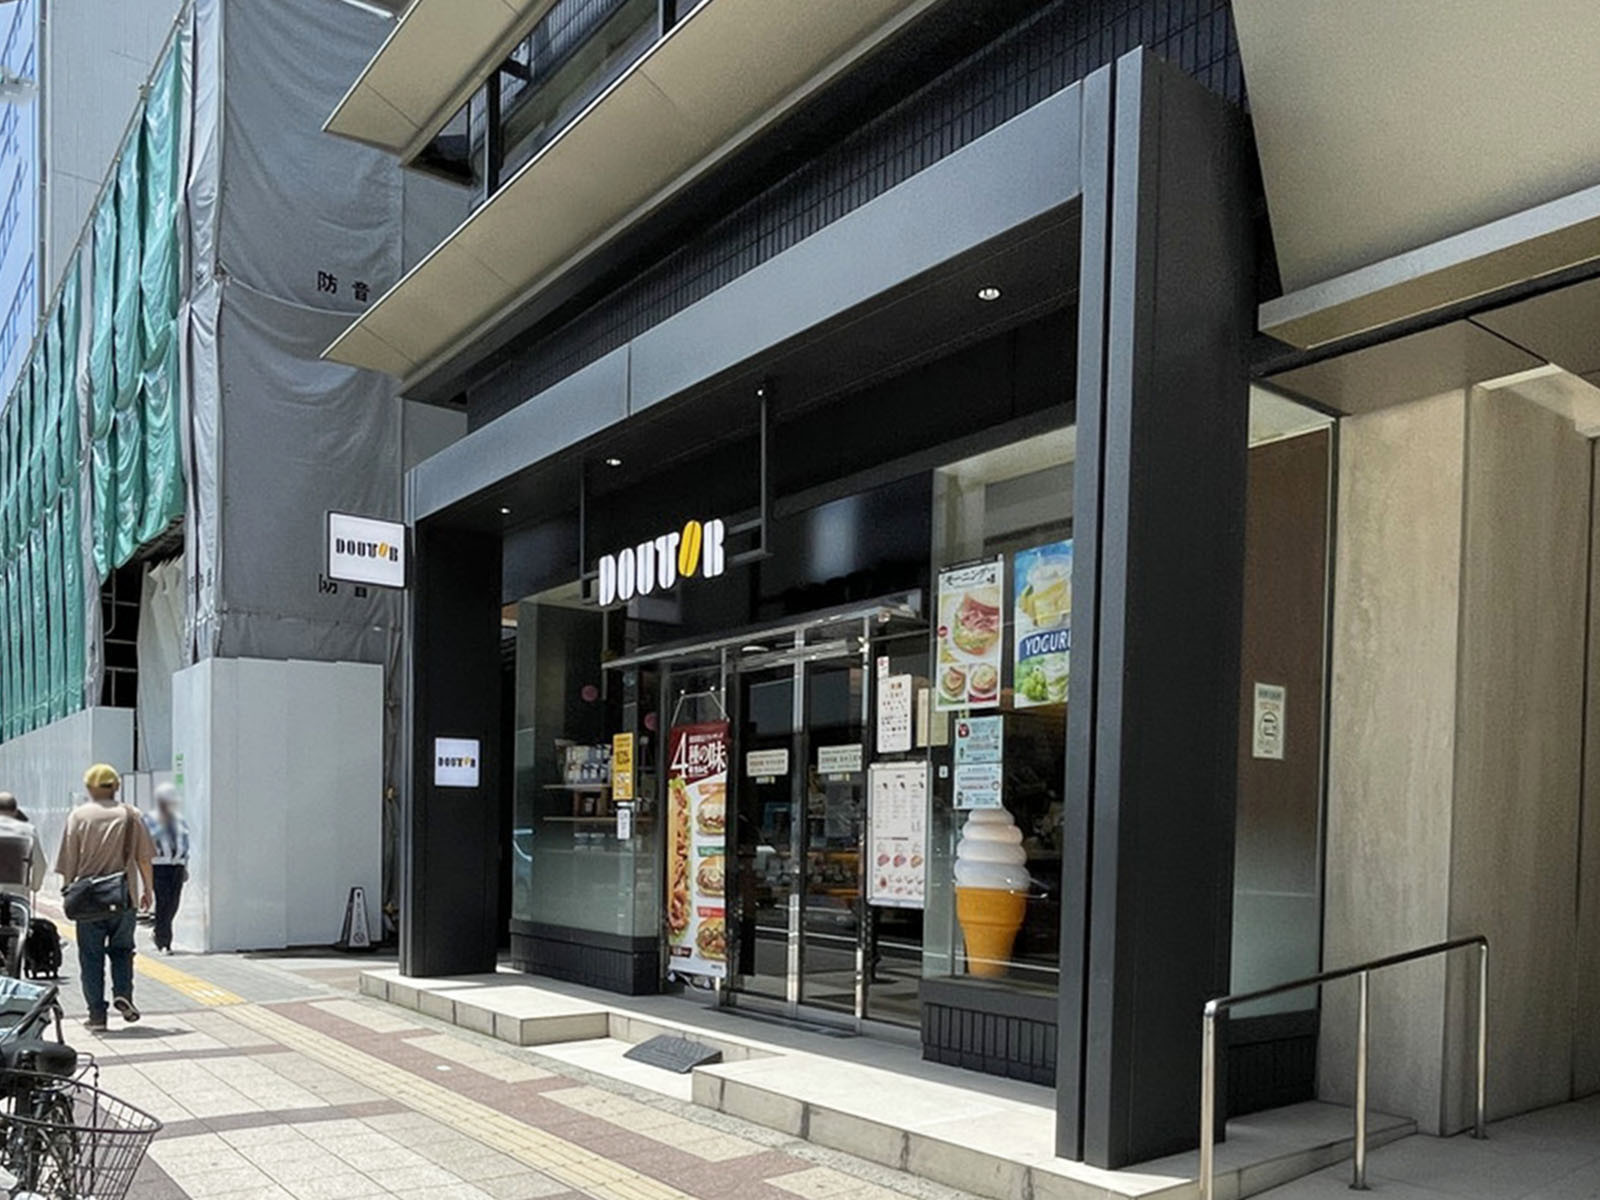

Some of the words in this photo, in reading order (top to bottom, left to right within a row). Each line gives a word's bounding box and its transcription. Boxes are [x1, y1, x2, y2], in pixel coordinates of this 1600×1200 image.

[317, 270, 370, 302] 防音
[335, 538, 399, 562] DOUTOR
[599, 518, 725, 607] DOUTOR
